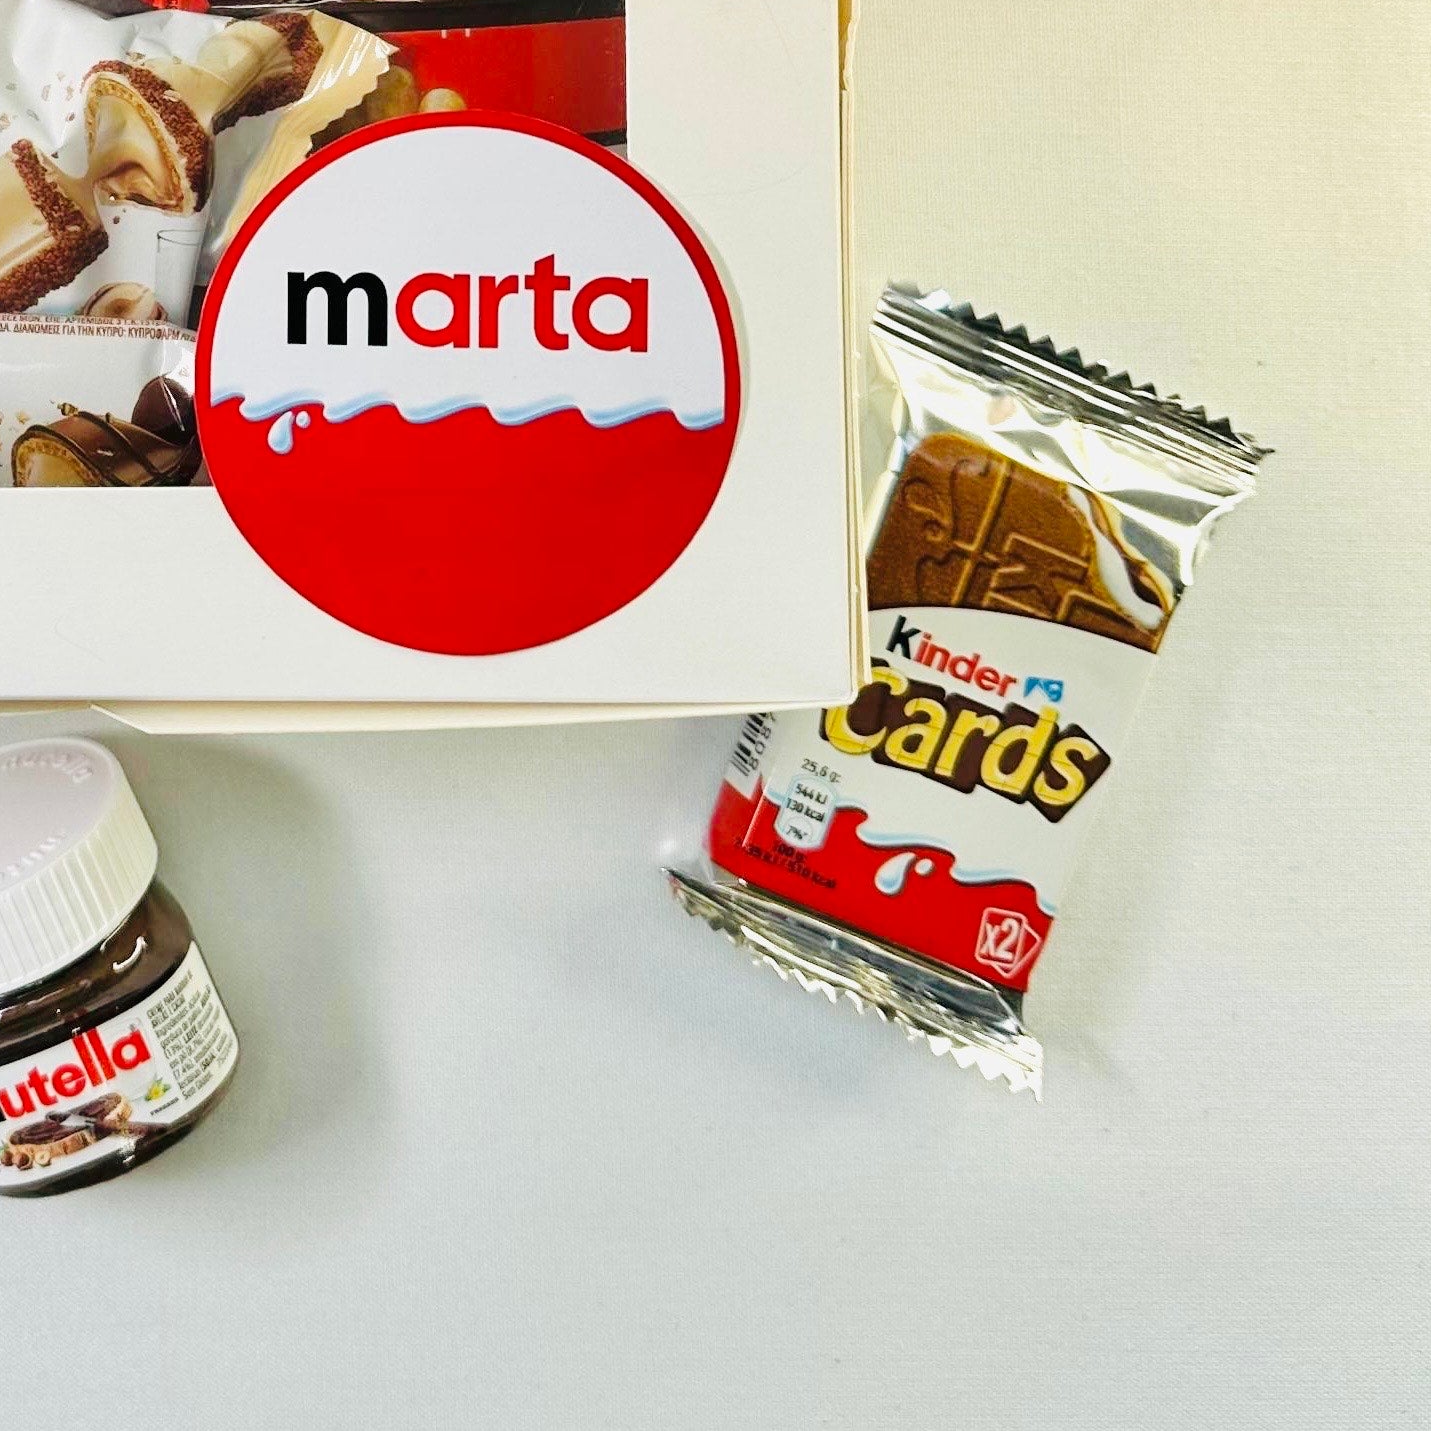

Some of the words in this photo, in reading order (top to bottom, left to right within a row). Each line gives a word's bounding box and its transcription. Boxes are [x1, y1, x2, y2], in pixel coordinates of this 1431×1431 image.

[286, 253, 649, 353] marta
[885, 615, 1019, 699] kinder
[824, 666, 1102, 809] Cards
